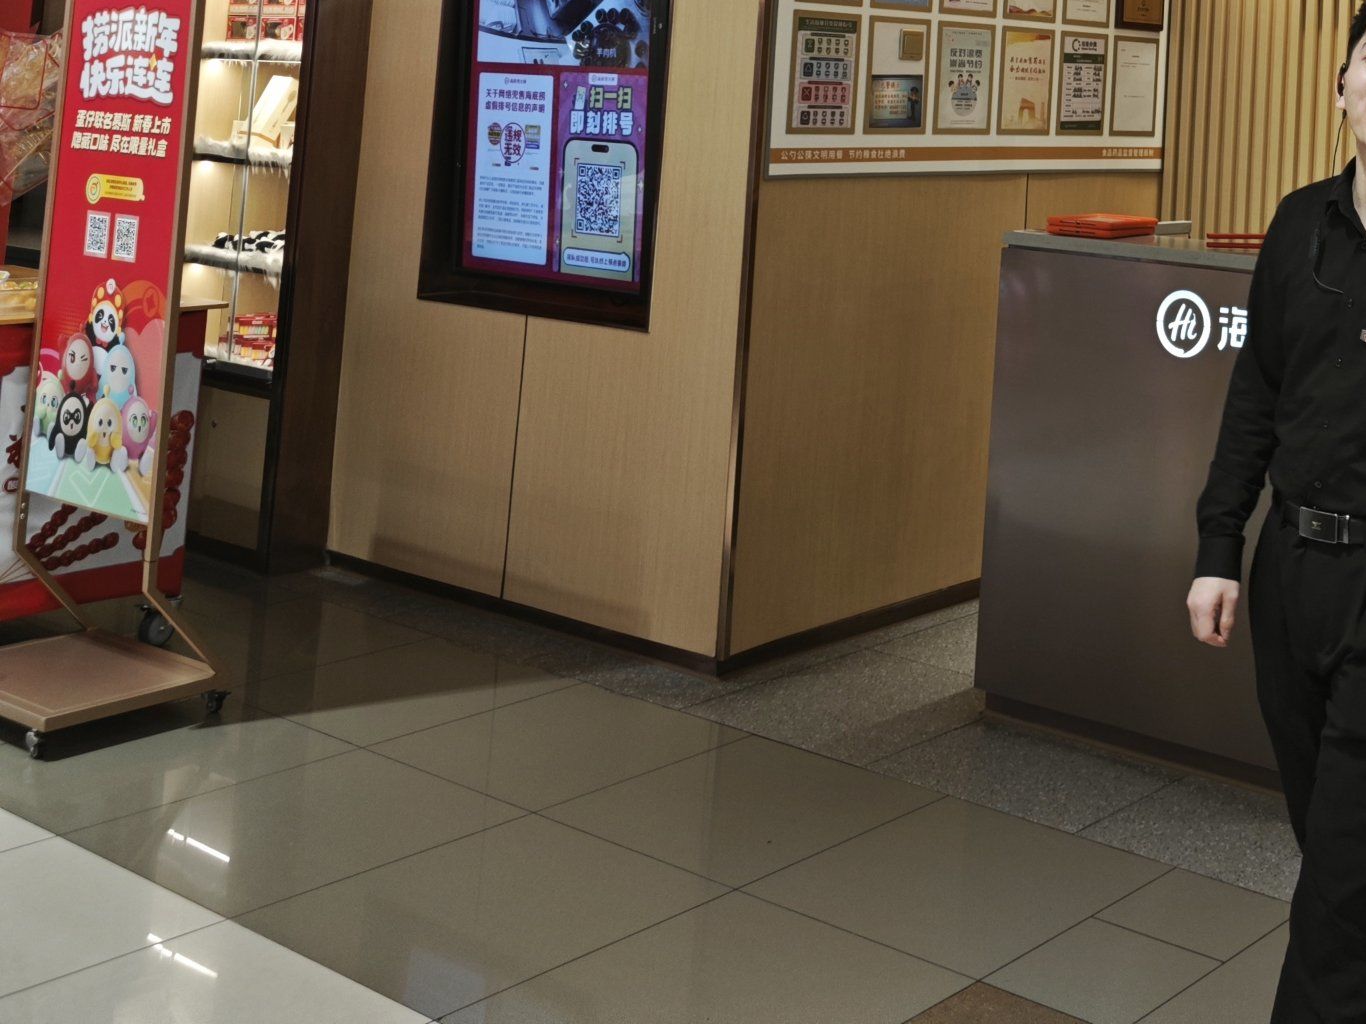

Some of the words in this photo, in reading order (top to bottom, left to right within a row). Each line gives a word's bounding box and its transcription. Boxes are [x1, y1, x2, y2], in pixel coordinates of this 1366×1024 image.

[82, 6, 180, 61] 捞派新年
[949, 58, 983, 70] 崇尚节约
[950, 48, 983, 60] 反对浪费
[80, 55, 174, 105] 快乐连连
[590, 86, 633, 109] 扫一扫
[132, 114, 172, 135] 新春上市
[570, 110, 634, 136] 即刻排号
[71, 131, 110, 151] 隐藏口味
[110, 134, 168, 158] 尽在限量礼盒
[504, 127, 522, 143] 违规
[504, 142, 522, 156] 无效
[780, 149, 843, 160] 公勺公筷文明用餐
[848, 149, 906, 160] 节约粮食杜绝浪费
[1217, 306, 1248, 351] 海
